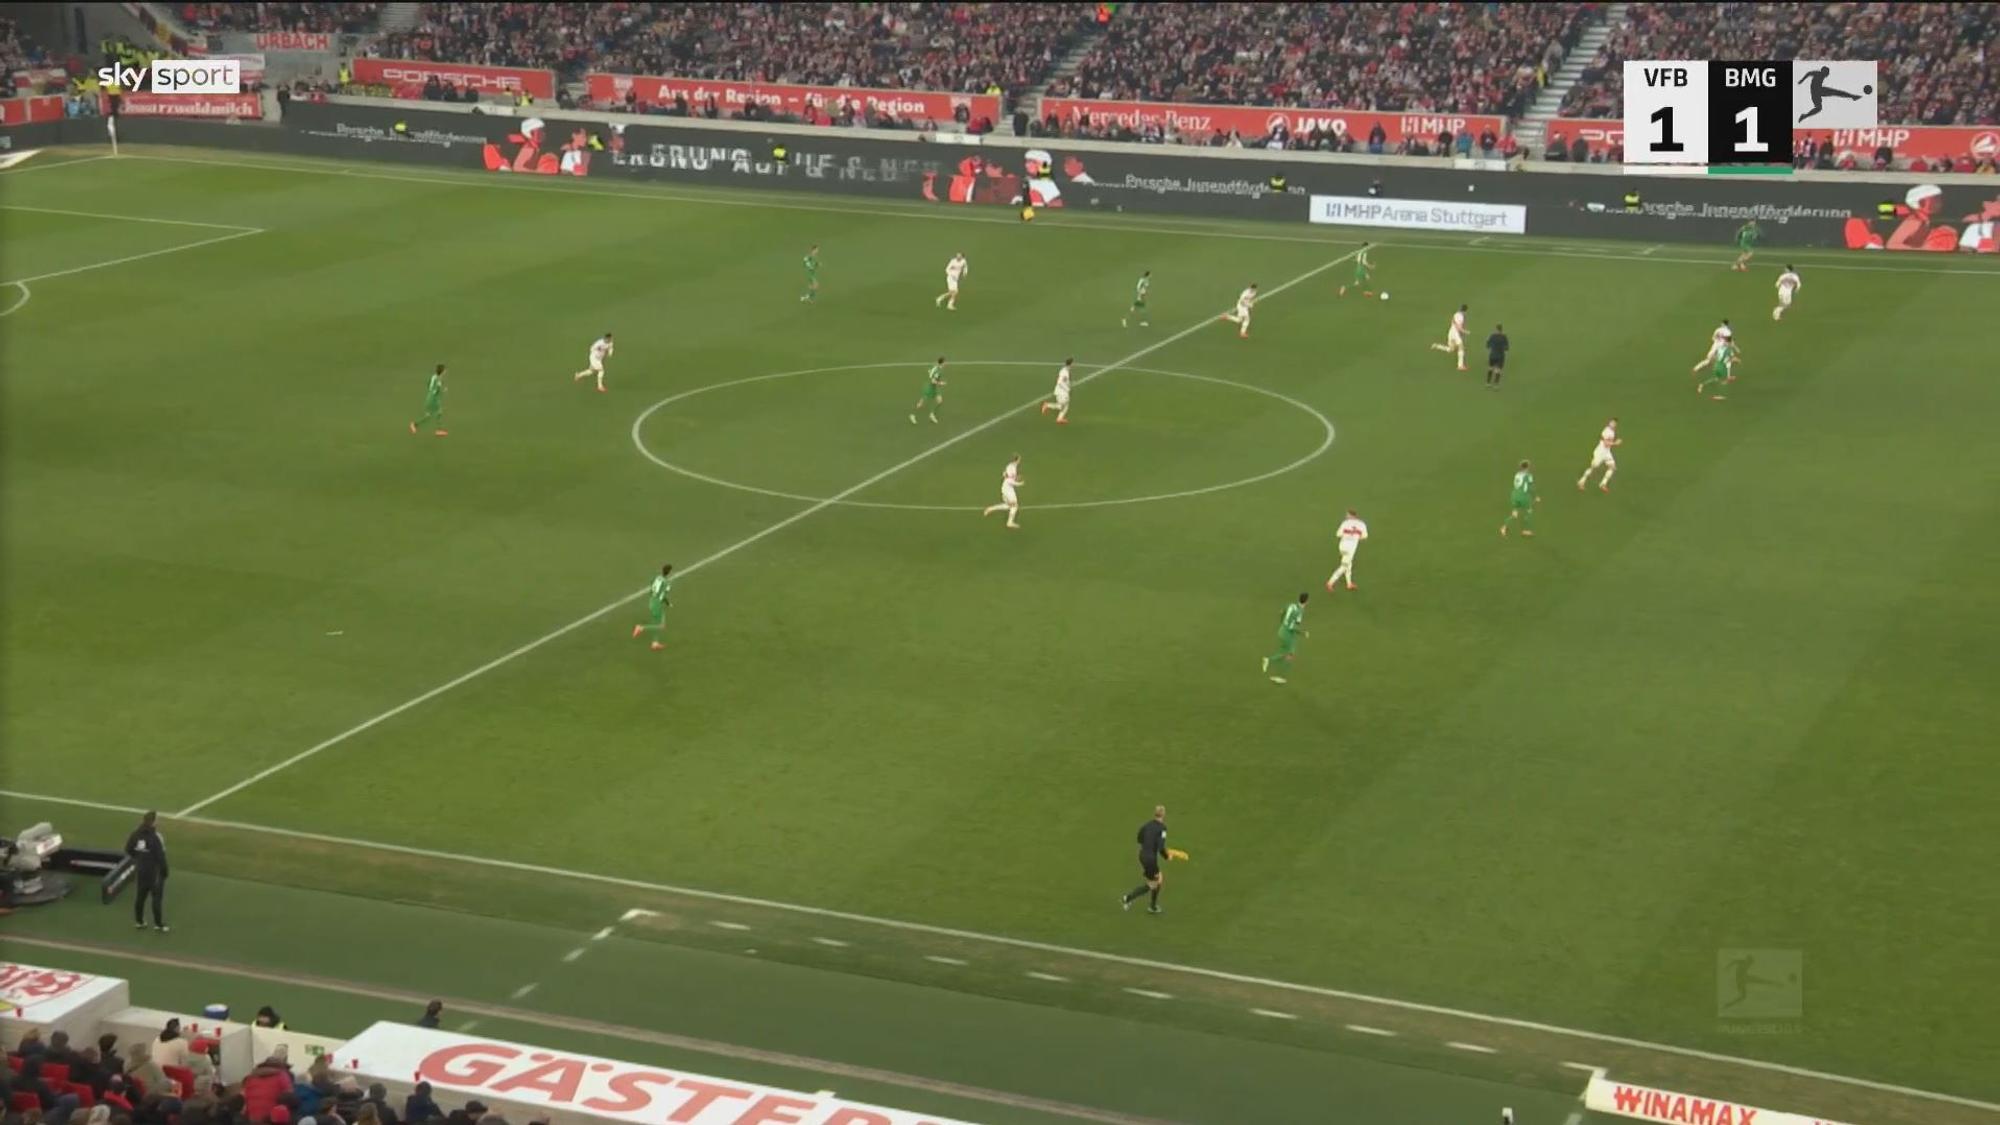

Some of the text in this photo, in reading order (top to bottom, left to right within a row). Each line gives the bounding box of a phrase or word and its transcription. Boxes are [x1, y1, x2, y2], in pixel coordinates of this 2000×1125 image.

[257, 33, 329, 50] URBACH
[383, 68, 522, 90] PORSCHE
[118, 99, 253, 115] chwarzwaldmilch
[836, 94, 861, 110] de
[1857, 130, 1910, 147] MHP
[1344, 204, 1508, 228] MHP Arena Stuttgart
[1614, 1086, 1757, 1125] WINAMAX
